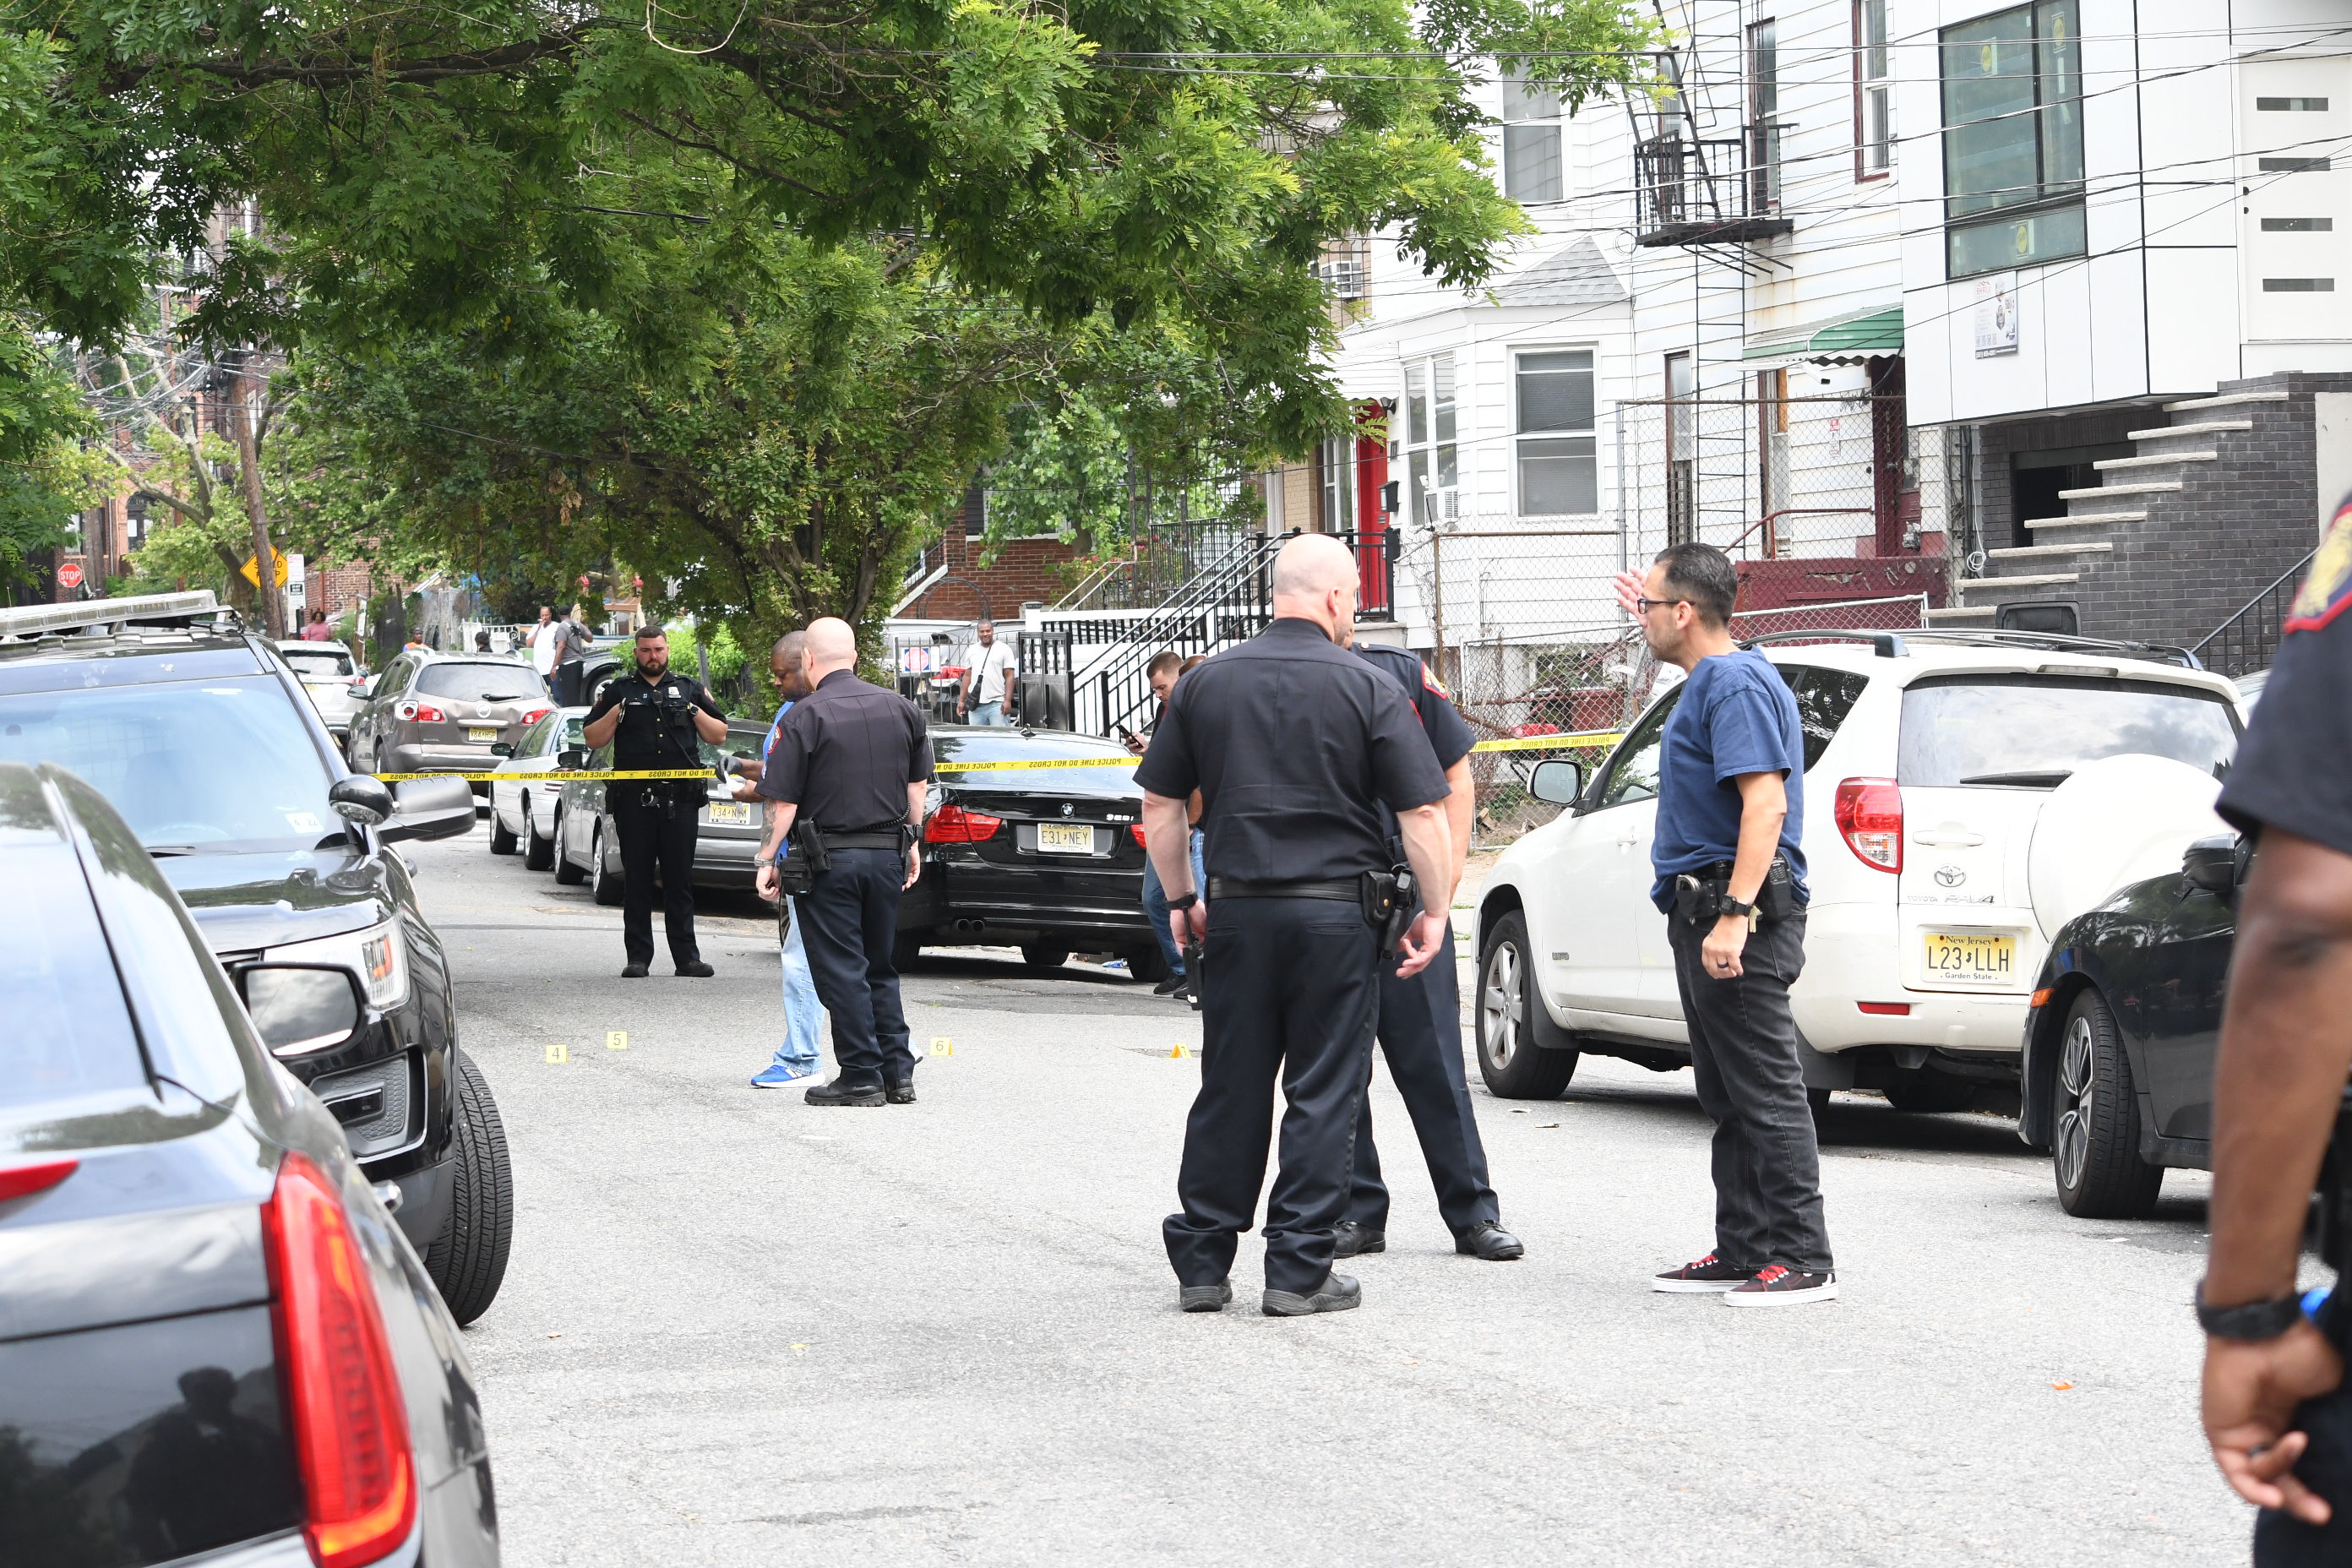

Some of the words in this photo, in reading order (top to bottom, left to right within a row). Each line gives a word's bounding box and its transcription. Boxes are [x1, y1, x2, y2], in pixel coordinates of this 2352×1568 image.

[60, 570, 81, 580] STOP
[712, 807, 727, 818] Y34
[732, 808, 748, 819] NM
[1042, 830, 1062, 845] E31
[1069, 831, 1088, 846] NEY
[1907, 895, 1938, 903] TOYOTA
[1946, 935, 1965, 945] New
[1966, 936, 1993, 947] Jersey
[1928, 945, 1962, 971] L23
[1974, 947, 2009, 973] LLH
[1945, 972, 1971, 980] Garden
[1973, 972, 1993, 981] State
[613, 1033, 621, 1046] 5
[936, 1040, 944, 1052] 6
[552, 1047, 560, 1059] 4
